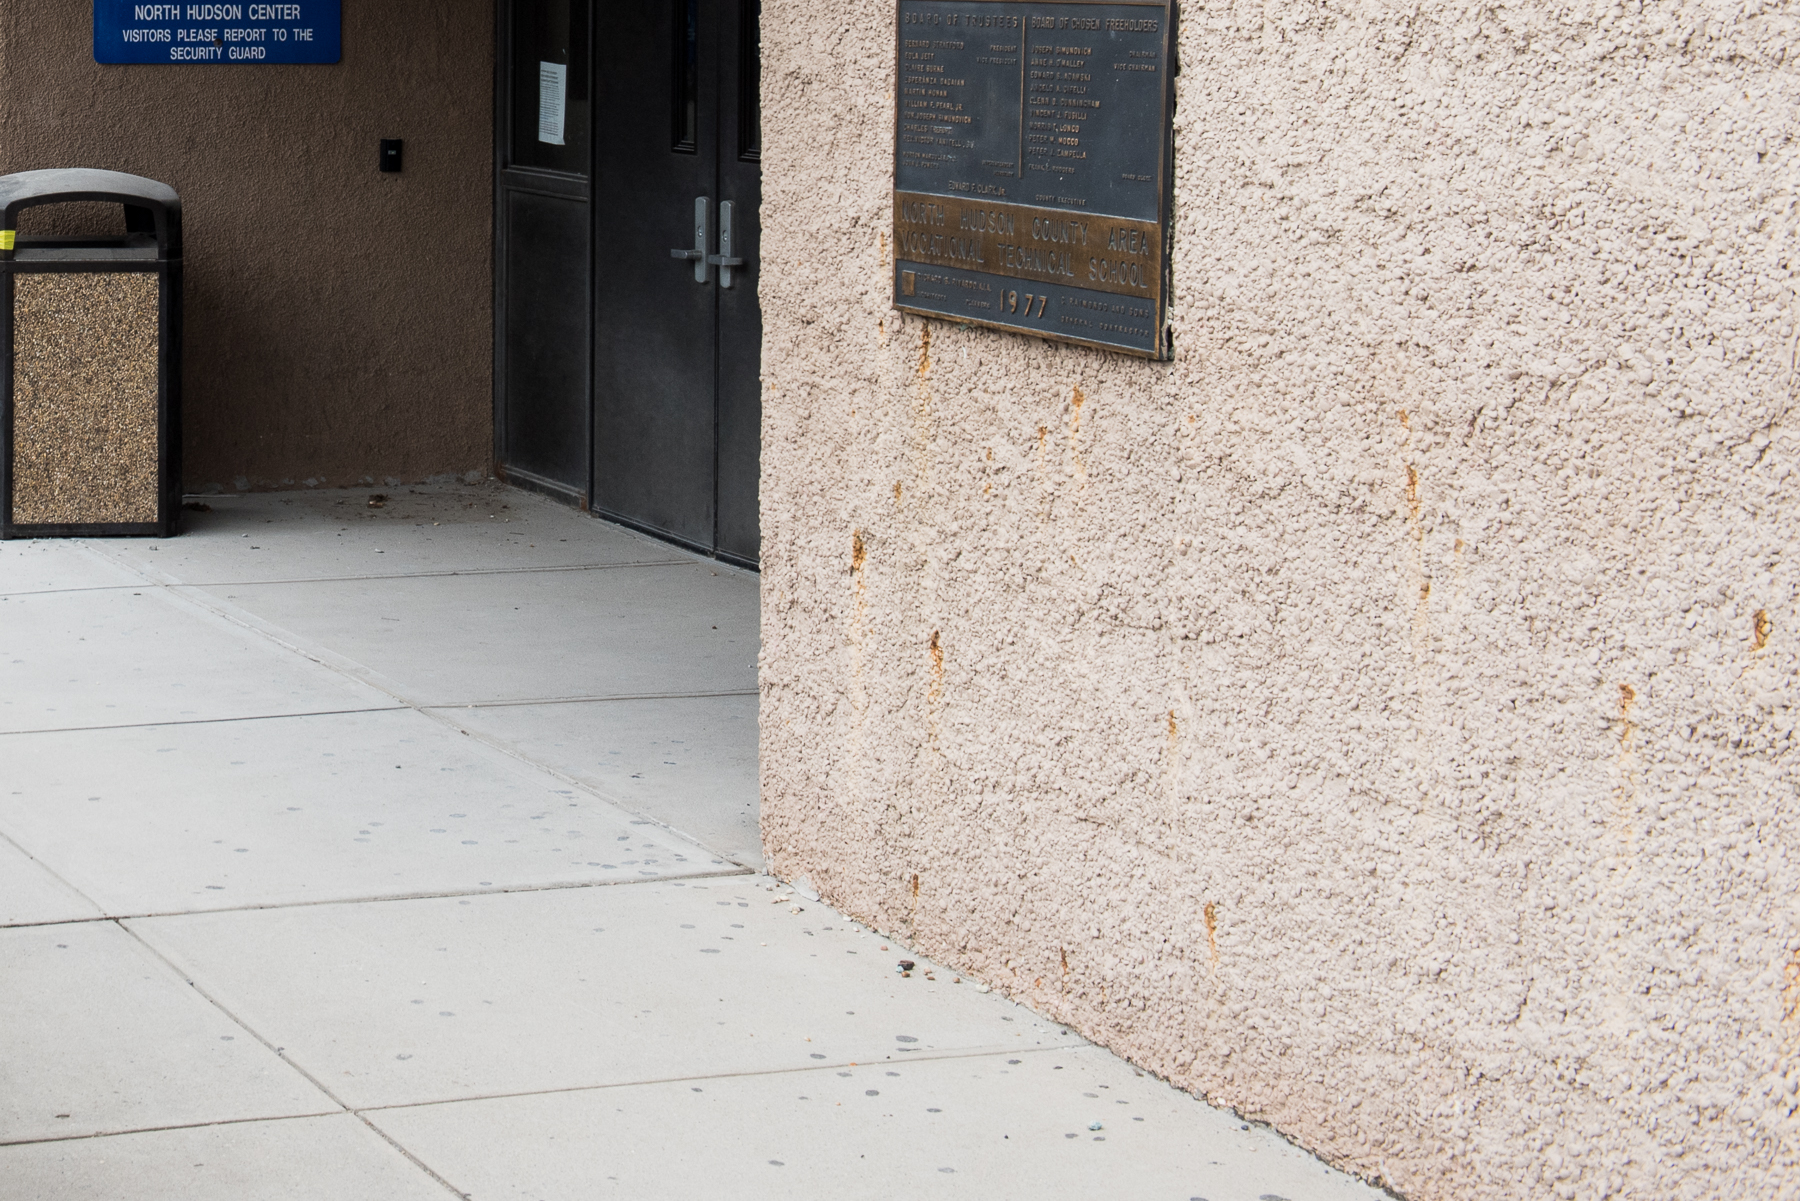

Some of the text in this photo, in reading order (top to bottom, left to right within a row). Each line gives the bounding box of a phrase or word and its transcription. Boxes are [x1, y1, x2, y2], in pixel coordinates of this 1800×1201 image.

[135, 5, 300, 20] NORTH HUDSON CENTER
[905, 12, 1018, 28] BOARD OF TRUSTEES
[1031, 16, 1158, 33] BOARD OF CHOSEN FREEHOLDERS
[122, 29, 313, 42] VISITORS PLEASE REPORT TO THE
[170, 47, 265, 60] SECURITY GUARD
[1031, 45, 1053, 54] JOSEPH
[949, 180, 969, 192] EDWARD
[902, 200, 1149, 256] NORTH HUDSON COUNTY AREA
[901, 230, 1148, 290] VOCATIONAL TECHNICAL SCHOOL
[999, 288, 1047, 319] 1977
[1111, 304, 1125, 315] AND
[1128, 307, 1149, 318] SONS
